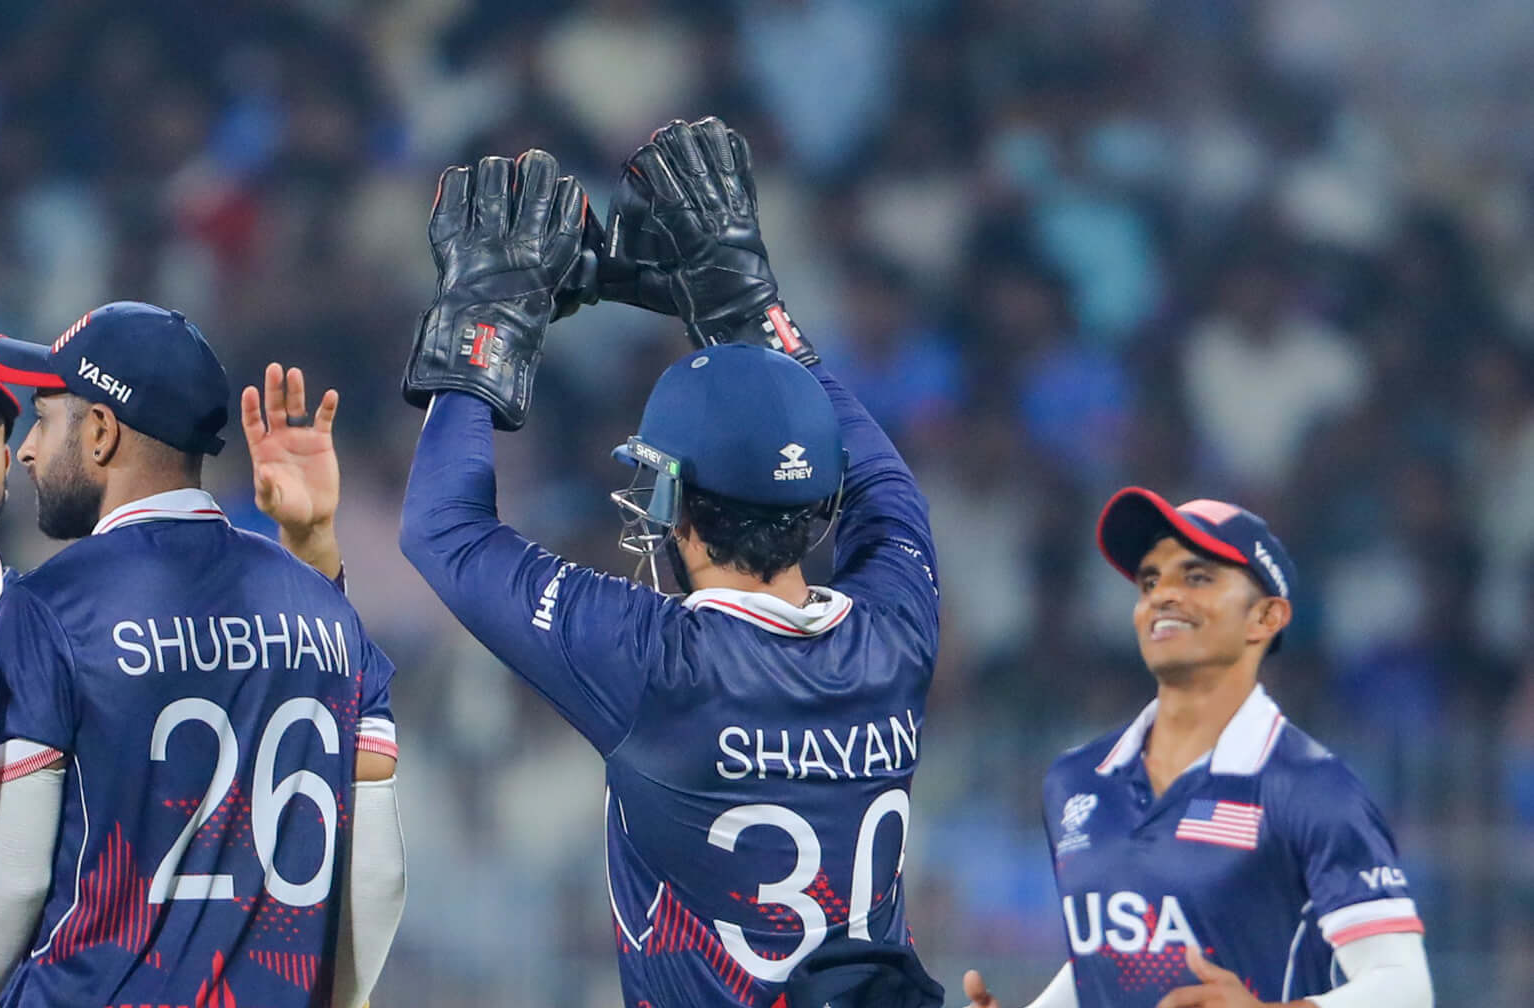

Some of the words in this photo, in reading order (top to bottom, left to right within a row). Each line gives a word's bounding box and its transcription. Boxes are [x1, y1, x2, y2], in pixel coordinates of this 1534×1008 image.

[77, 356, 133, 403] YASHI
[636, 443, 662, 465] SHREY
[773, 466, 814, 481] SHREY
[113, 613, 350, 678] SHUBHAM
[716, 709, 917, 780] SHAYAN
[148, 697, 340, 907] 26
[707, 788, 910, 983] 30
[1063, 891, 1203, 956] USA
